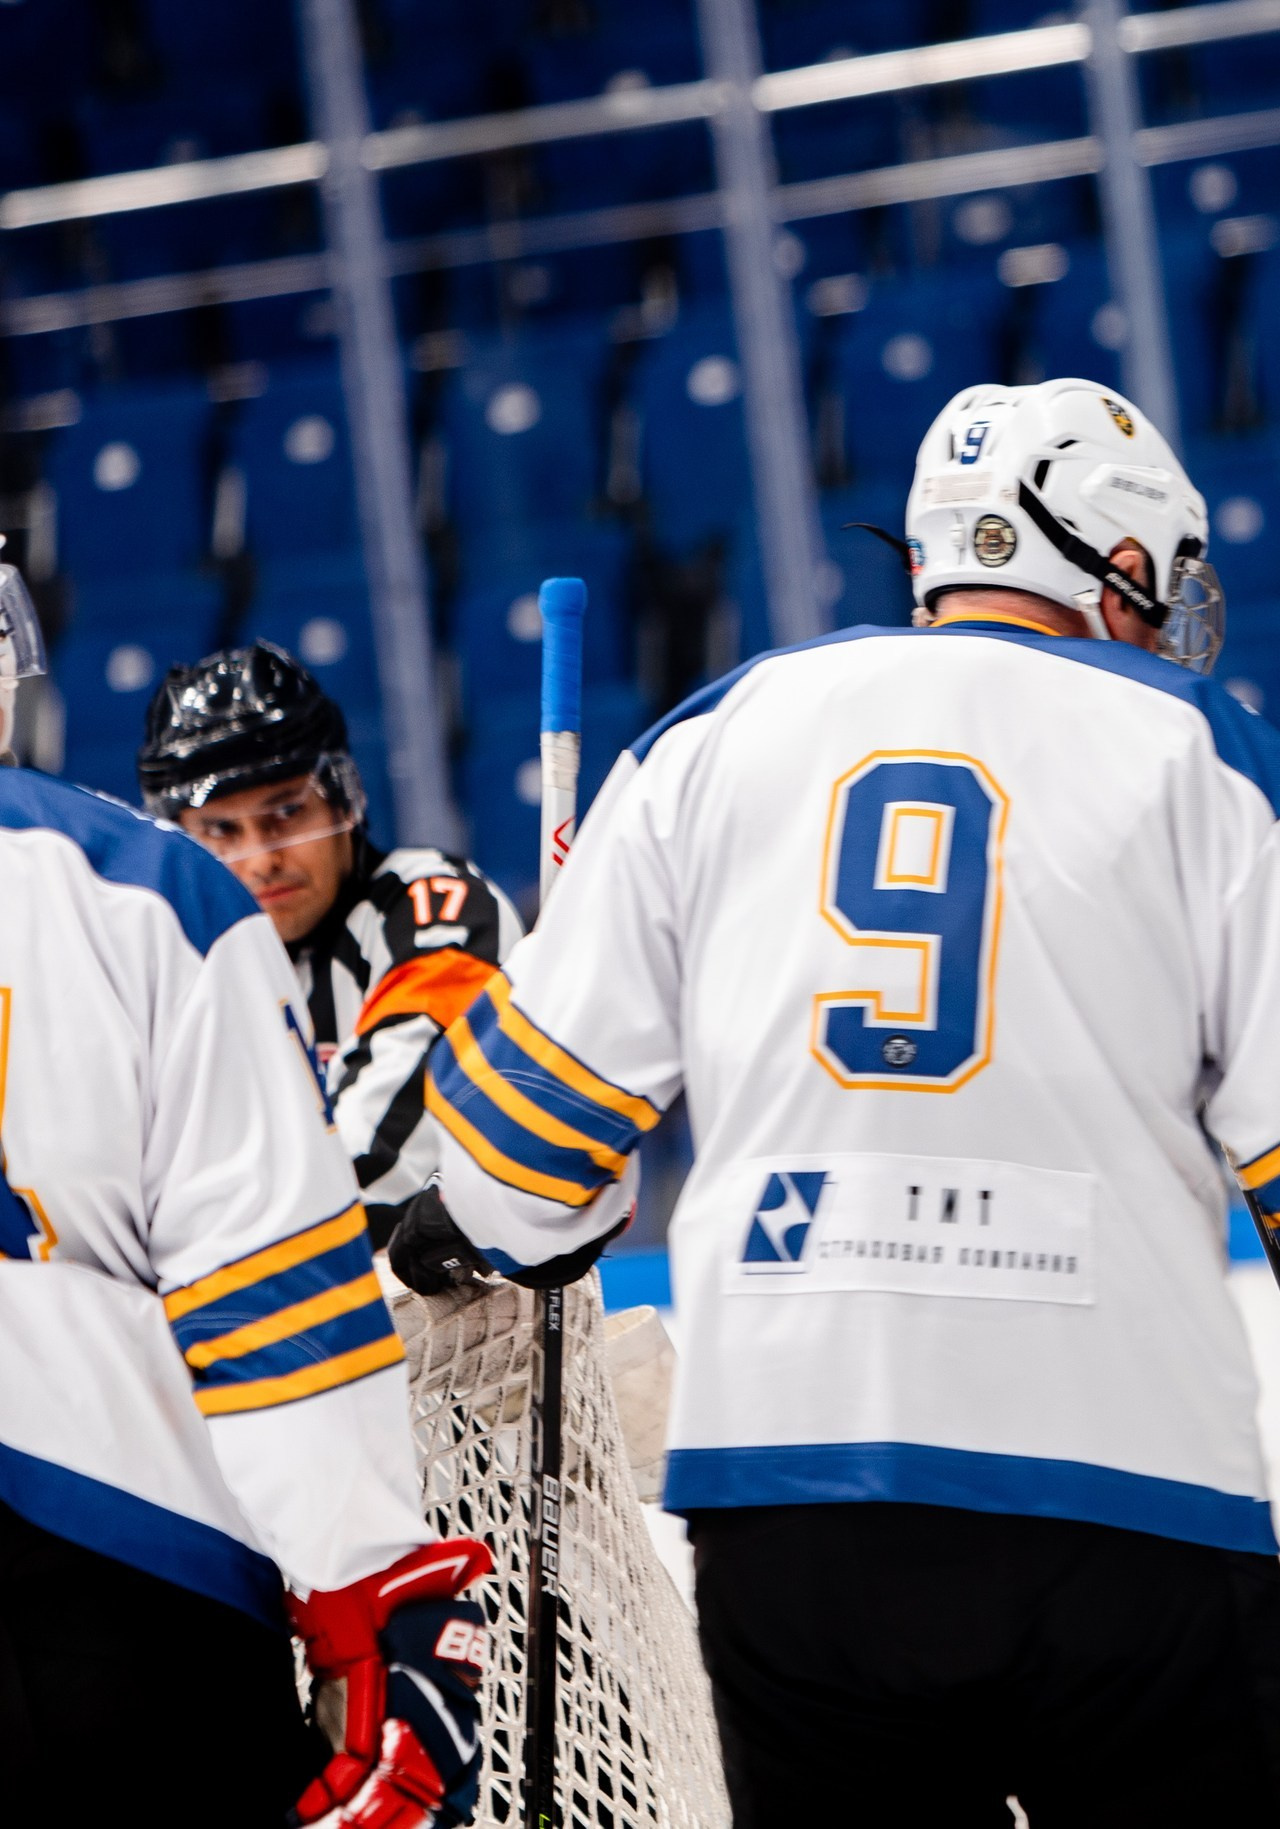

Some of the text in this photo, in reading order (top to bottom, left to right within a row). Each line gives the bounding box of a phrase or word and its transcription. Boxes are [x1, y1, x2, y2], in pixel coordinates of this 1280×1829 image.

[960, 420, 990, 466] 9
[407, 875, 469, 926] 17
[810, 749, 1011, 1094] 9
[541, 1473, 560, 1598] BAUER
